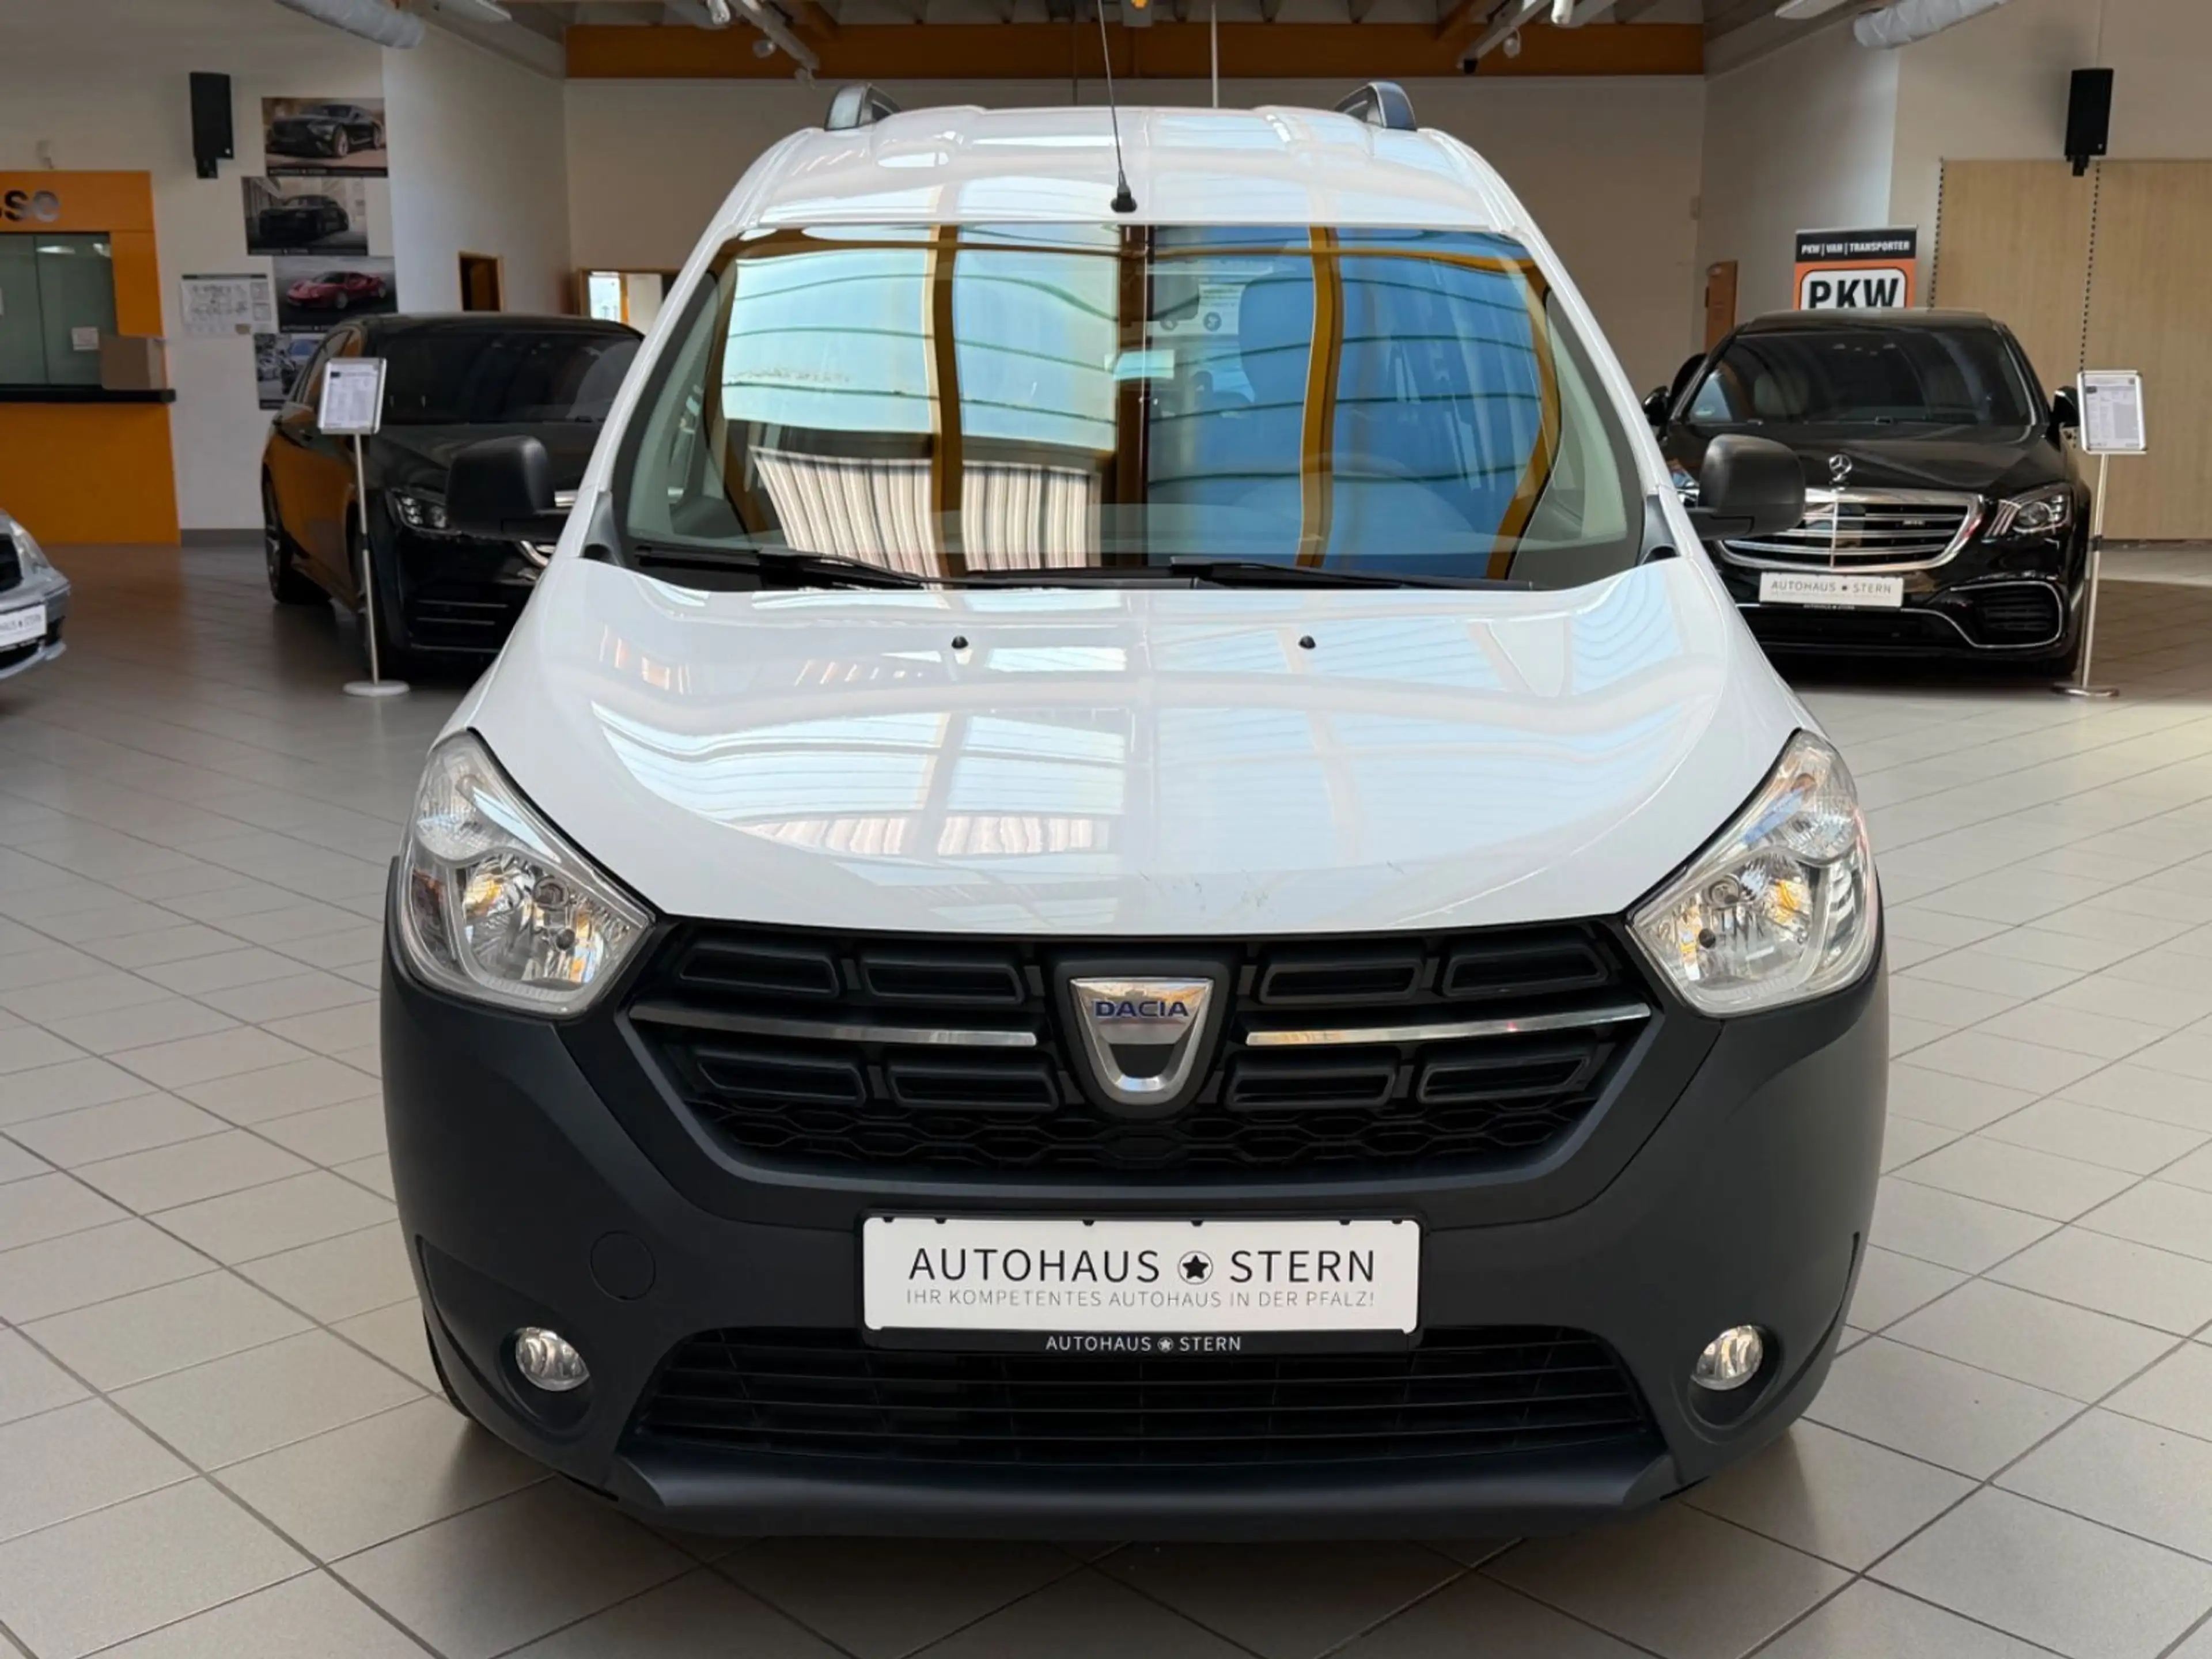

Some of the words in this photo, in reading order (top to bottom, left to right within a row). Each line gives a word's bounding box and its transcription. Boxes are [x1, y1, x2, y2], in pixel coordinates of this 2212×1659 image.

[1801, 244, 1820, 255] PKW
[1826, 243, 1843, 253] VAN
[1850, 240, 1910, 252] TRANSPORTER
[1809, 278, 1899, 309] PKW
[1771, 580, 1836, 592] AUTOHAUS
[1852, 582, 1892, 594] STERN
[1094, 1001, 1189, 1017] DACIA
[908, 1248, 1160, 1283] AUTOHAUS
[1229, 1249, 1374, 1283] STERN
[906, 1289, 942, 1305] IHR
[949, 1289, 1103, 1307] KOMPETENTES
[1108, 1291, 1222, 1308] AUTOHAUS
[1229, 1291, 1250, 1307] IN
[1259, 1291, 1298, 1307] DER
[1306, 1291, 1375, 1307] PFALZ!
[1045, 1336, 1152, 1352] AUTOHAUS
[1179, 1336, 1242, 1352] STERN
